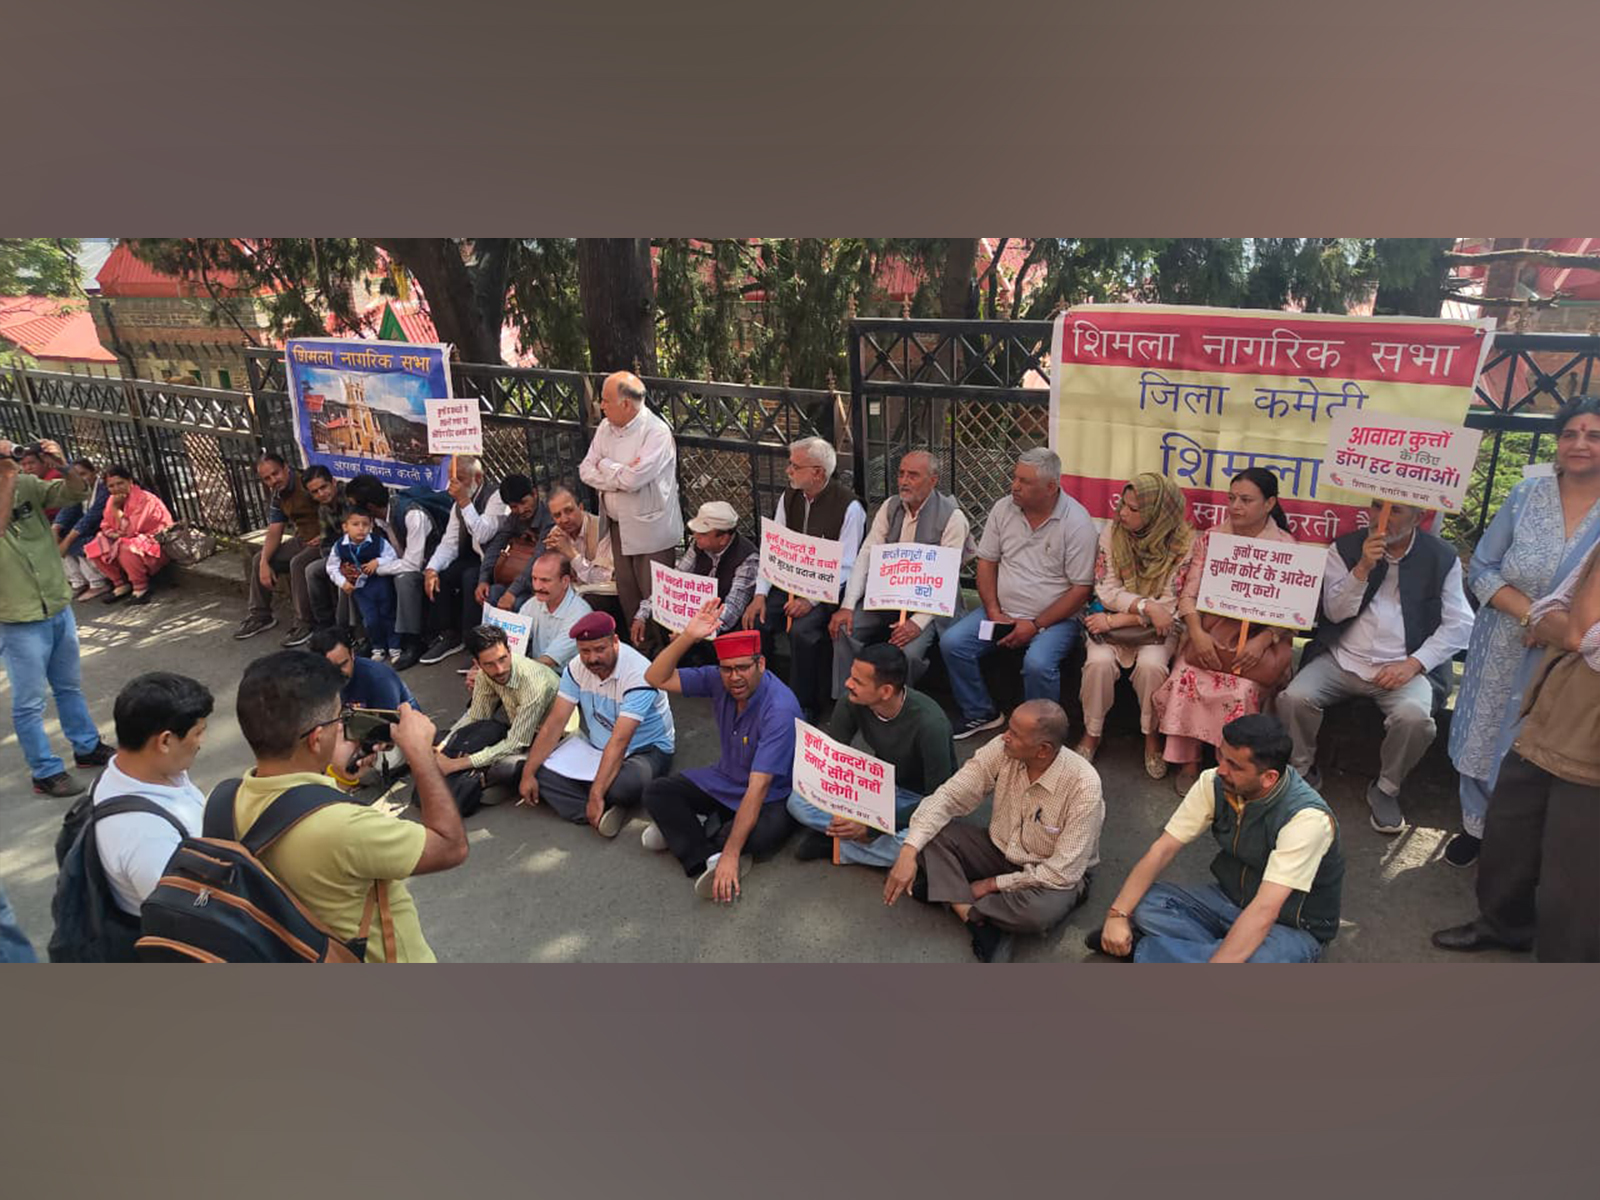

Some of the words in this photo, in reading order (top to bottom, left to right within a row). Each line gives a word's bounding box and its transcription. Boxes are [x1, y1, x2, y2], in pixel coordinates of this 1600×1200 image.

[292, 345, 333, 365] शिमला
[339, 347, 394, 368] नागरिक
[399, 355, 431, 373] सभा
[1072, 320, 1180, 362] शिमला
[1202, 328, 1345, 369] नागरिक
[1371, 342, 1460, 376] सभा
[1139, 371, 1230, 415] जिला
[1348, 427, 1406, 446] आवारा
[1409, 430, 1454, 452] कुत्तों
[1336, 447, 1368, 469] डॉग
[1369, 457, 1394, 474] हट
[1400, 449, 1413, 461] के
[1415, 450, 1441, 466] लिए
[1253, 547, 1269, 561] पर
[1269, 551, 1293, 565] आए
[889, 572, 943, 588] cunning
[1210, 557, 1238, 576] सुप्रीम
[1239, 562, 1263, 580] कोर्ट
[1263, 565, 1278, 581] के
[1280, 569, 1318, 588] आदेश
[915, 585, 932, 598] करो
[1230, 580, 1251, 598] लागू
[1252, 583, 1281, 599] करो।
[805, 749, 827, 773] स्मार्ट
[827, 765, 855, 785] सीटी
[868, 763, 884, 779] की
[820, 778, 858, 802] चलेगी।
